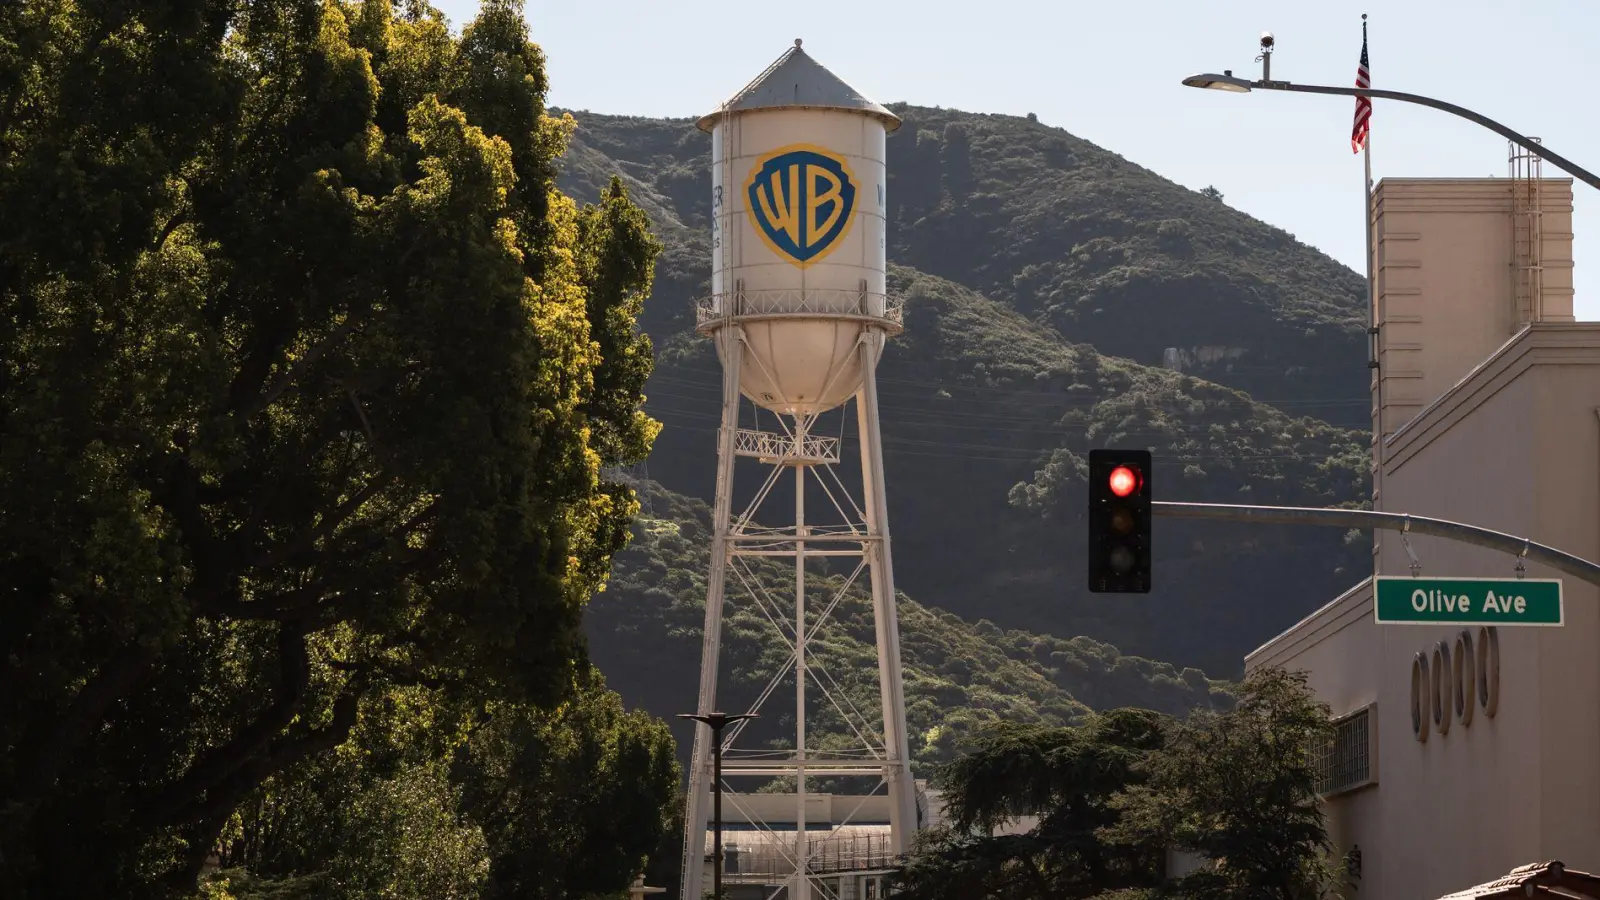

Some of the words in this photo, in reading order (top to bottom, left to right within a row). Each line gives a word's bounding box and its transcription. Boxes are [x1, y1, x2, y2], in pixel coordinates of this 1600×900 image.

[756, 164, 844, 248] WB
[1411, 589, 1471, 613] Olive
[1482, 590, 1527, 614] Ave
